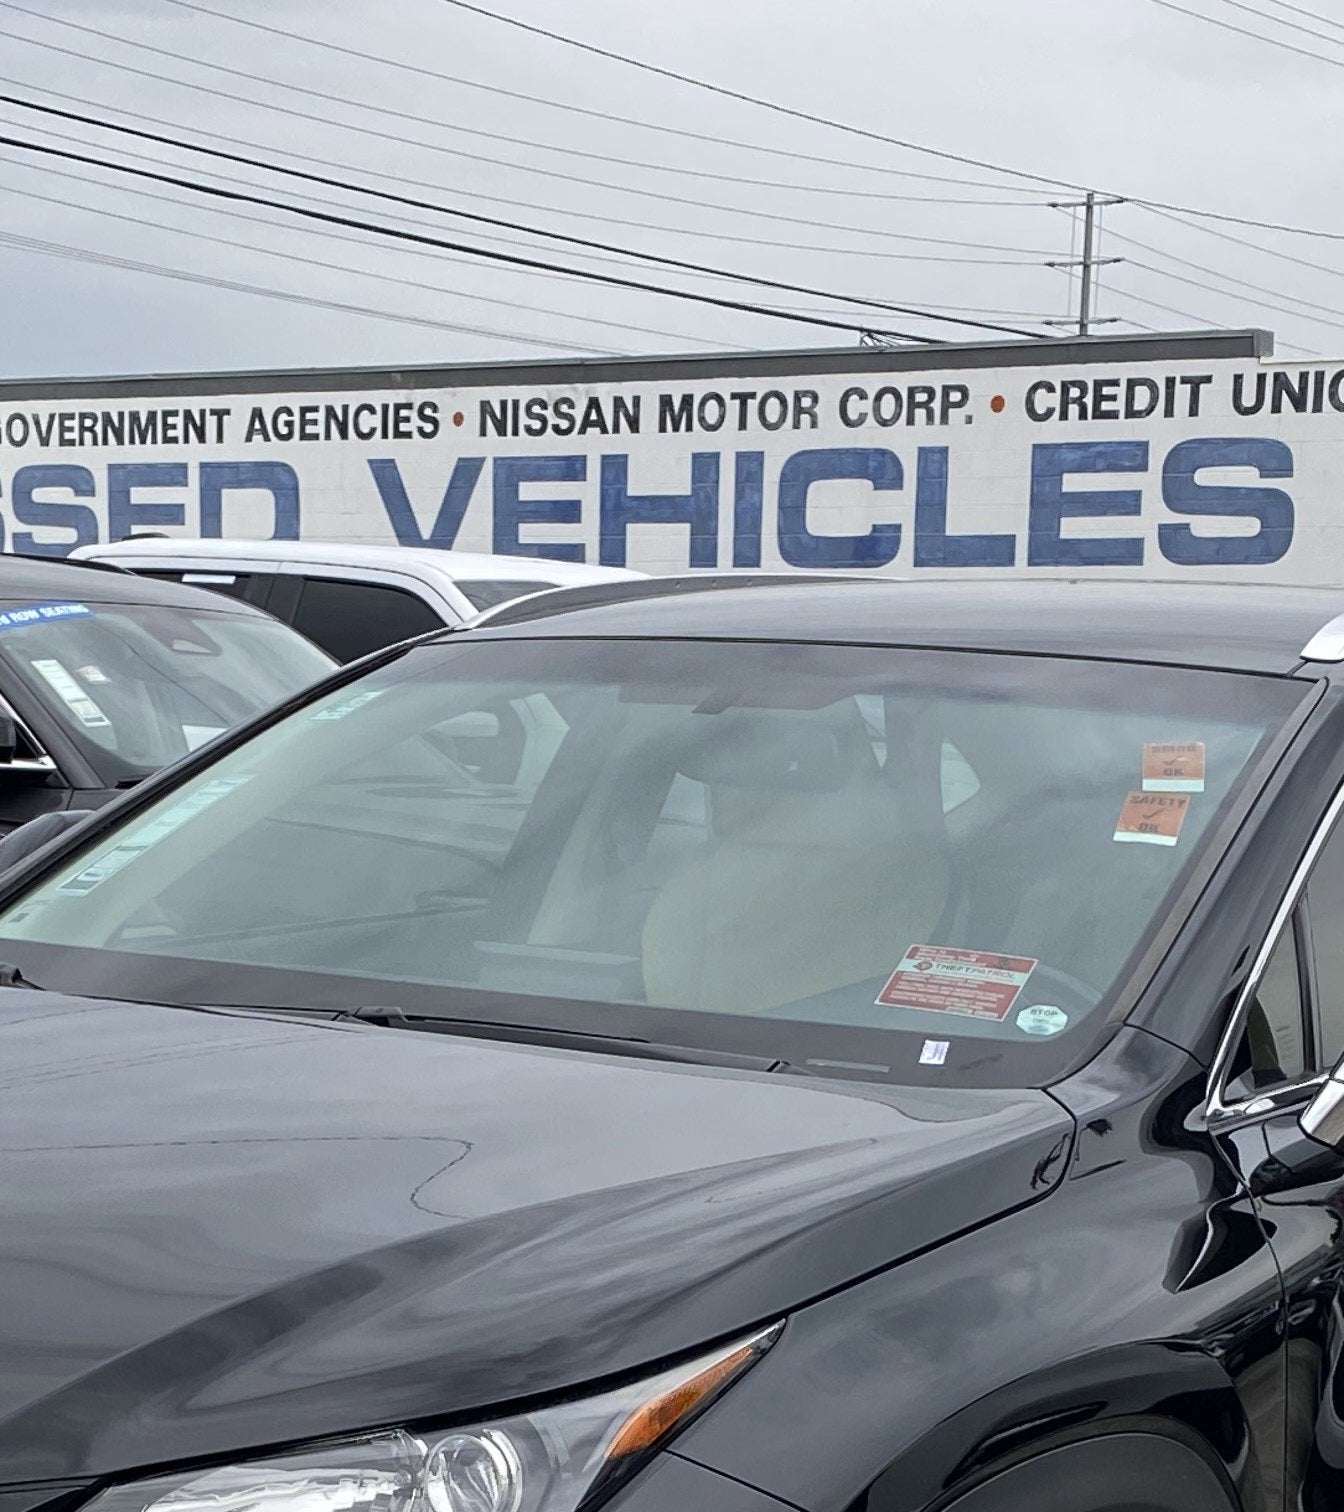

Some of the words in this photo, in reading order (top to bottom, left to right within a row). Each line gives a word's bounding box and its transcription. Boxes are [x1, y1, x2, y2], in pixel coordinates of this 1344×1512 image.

[244, 401, 440, 442] AGENCIES
[479, 395, 641, 439] NISSAN
[658, 389, 819, 434] MOTOR
[838, 384, 973, 428] CORP.
[1024, 374, 1213, 422] CREDIT
[369, 437, 1294, 568] VEHICLES
[9, 608, 40, 623] ROW
